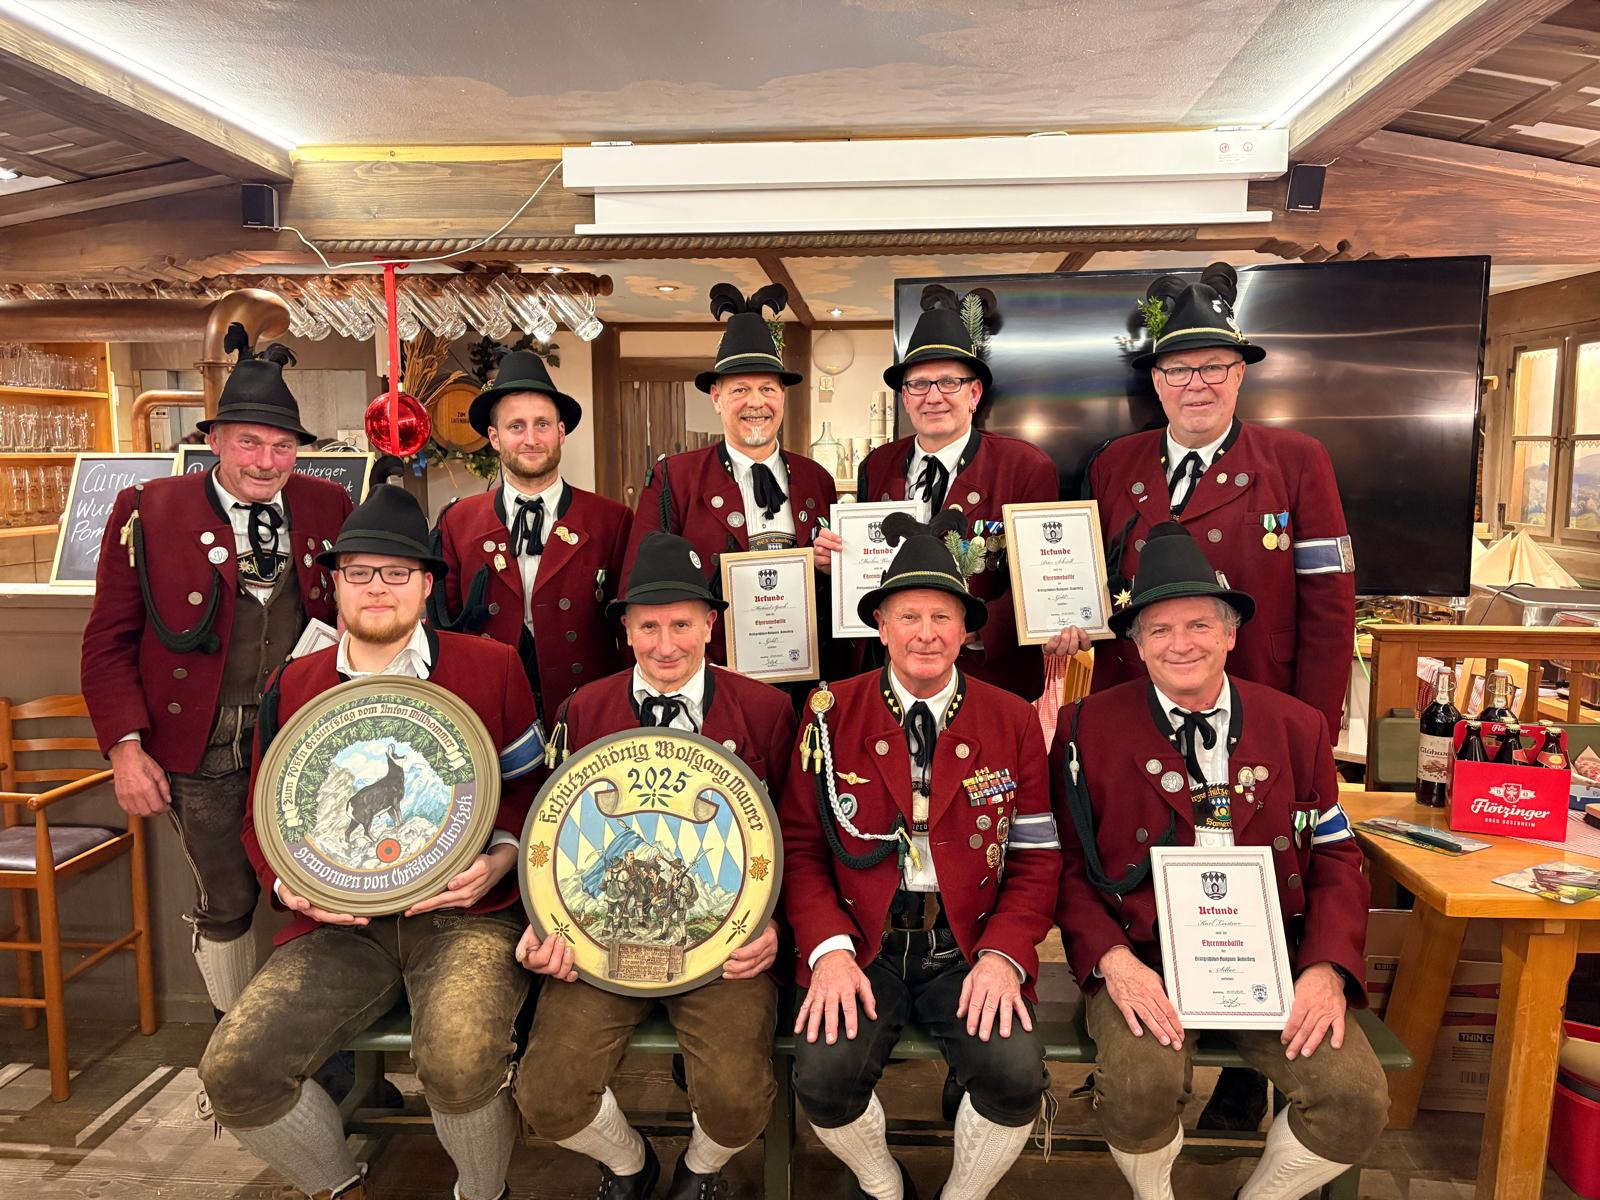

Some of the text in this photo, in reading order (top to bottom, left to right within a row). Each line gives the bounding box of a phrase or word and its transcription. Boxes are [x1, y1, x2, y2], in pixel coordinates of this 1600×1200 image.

[1040, 548, 1071, 556] Urkunde
[754, 595, 785, 603] Urkunde
[539, 740, 764, 831] Schützenkönig Wolfgang Maurer
[627, 766, 693, 793] 2025
[1470, 798, 1551, 820] Flötzinger
[363, 875, 390, 890] von
[391, 848, 444, 885] Christian
[1198, 906, 1239, 915] Urkunde
